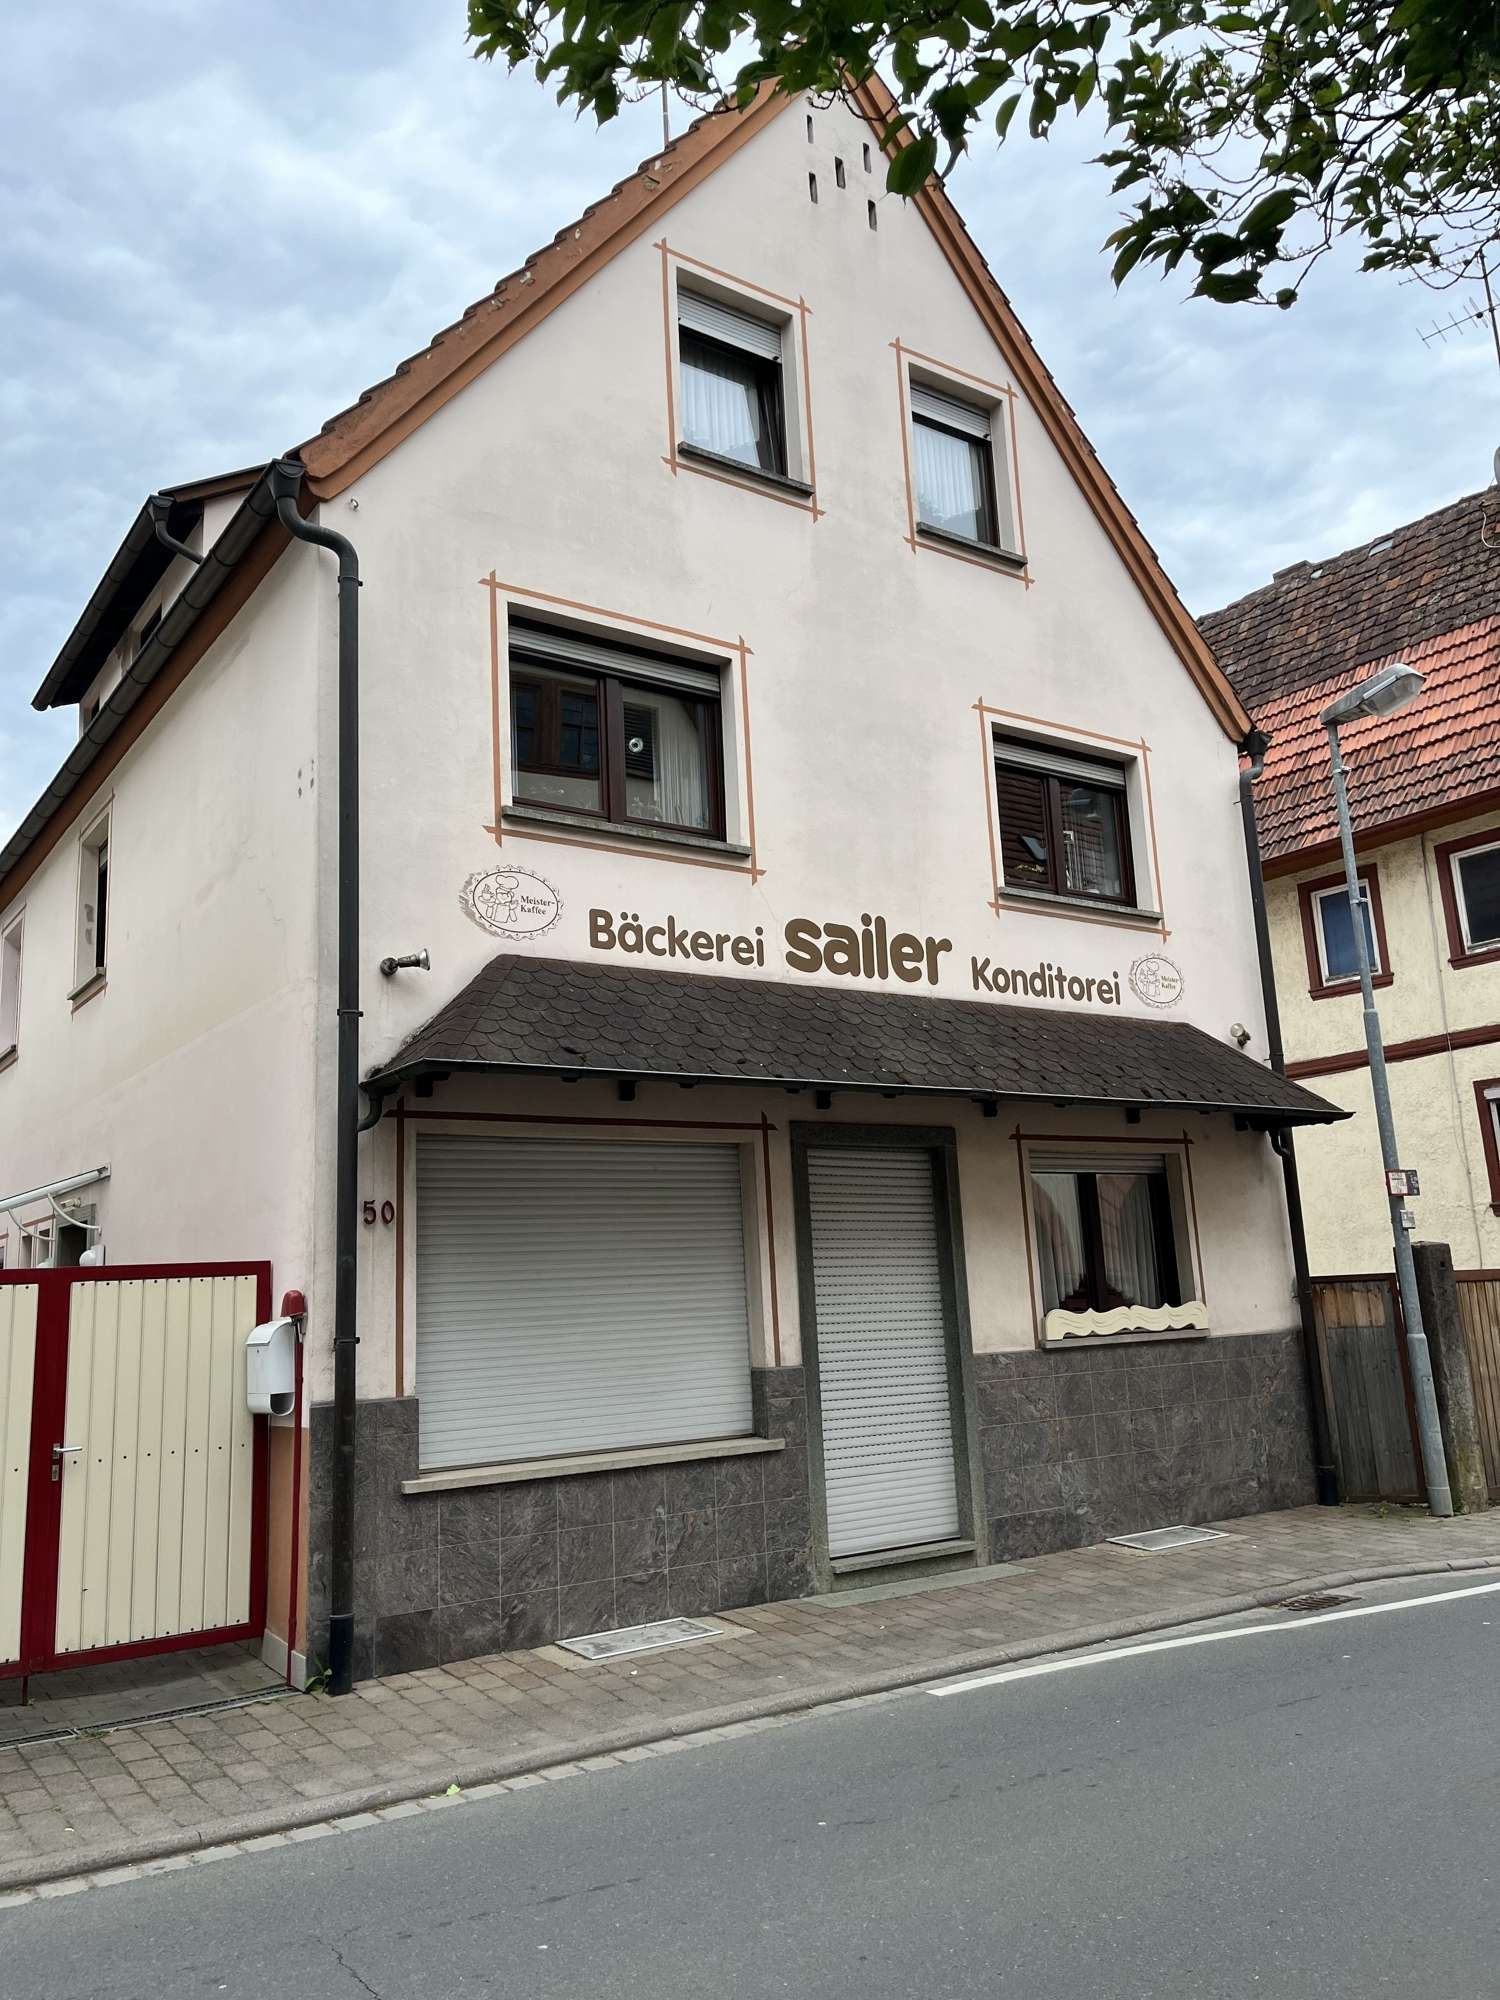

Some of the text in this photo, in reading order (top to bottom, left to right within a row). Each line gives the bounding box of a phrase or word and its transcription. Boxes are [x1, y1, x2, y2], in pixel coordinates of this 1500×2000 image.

[520, 905, 546, 915] Kaffee
[588, 908, 765, 967] Bäckerei
[970, 955, 1121, 1006] Konditorei
[362, 1199, 395, 1226] 50
